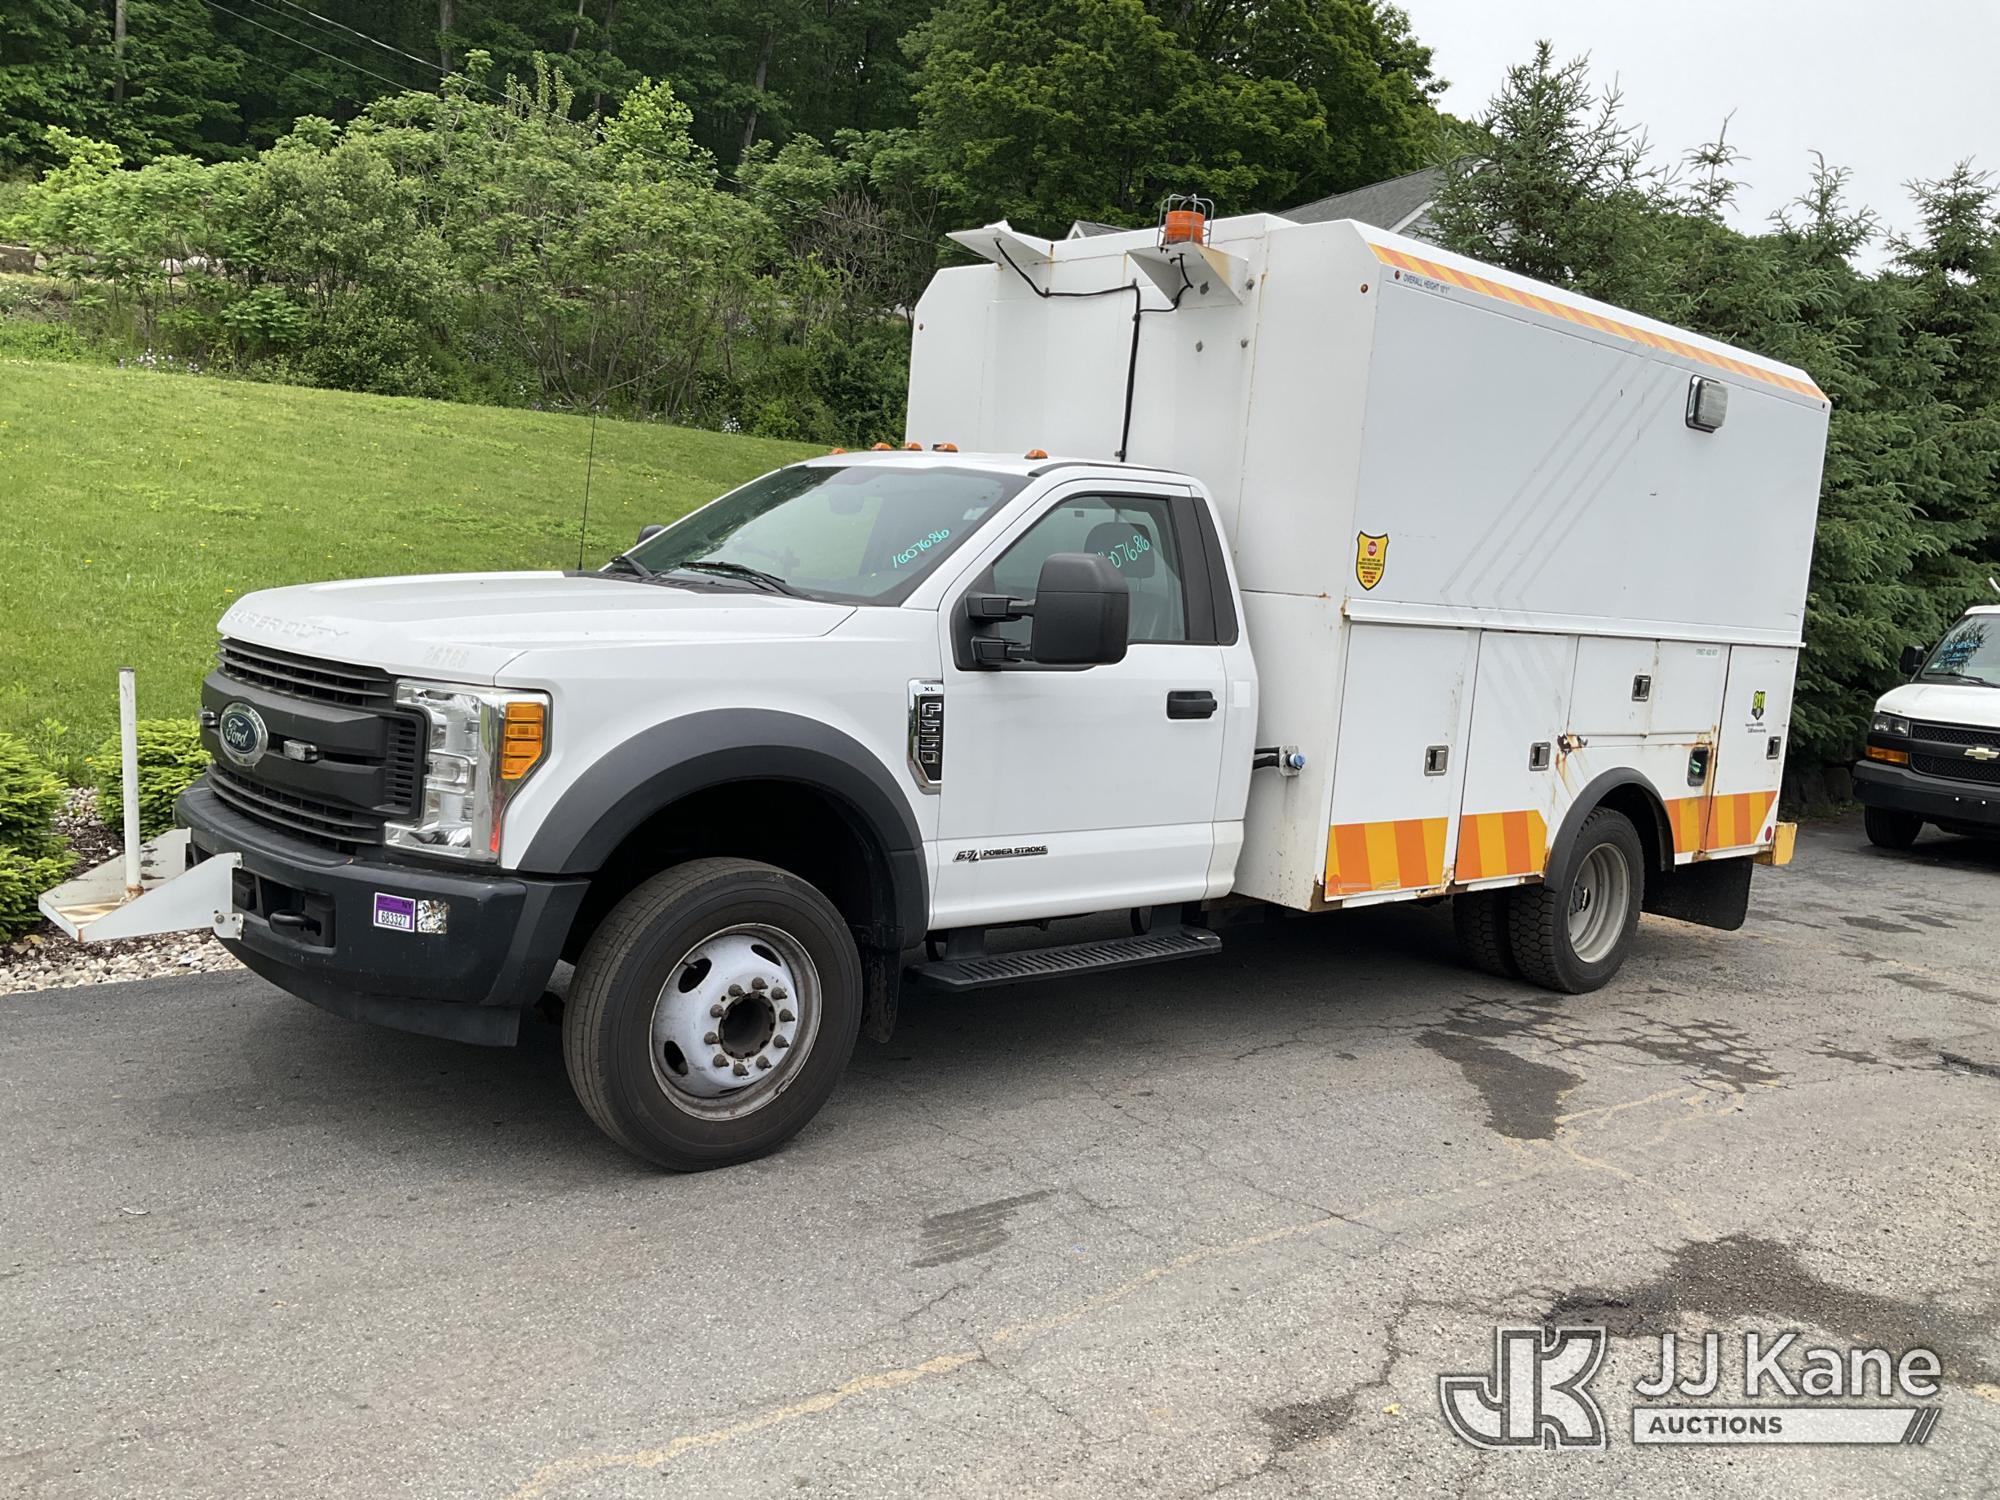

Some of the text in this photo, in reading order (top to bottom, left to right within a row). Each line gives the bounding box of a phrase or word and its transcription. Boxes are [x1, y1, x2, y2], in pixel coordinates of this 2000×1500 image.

[893, 529, 950, 569] 1607686
[226, 717, 249, 747] Ford
[983, 848, 1013, 857] POWER
[1014, 845, 1047, 855] STROKE
[381, 911, 408, 927] 683327
